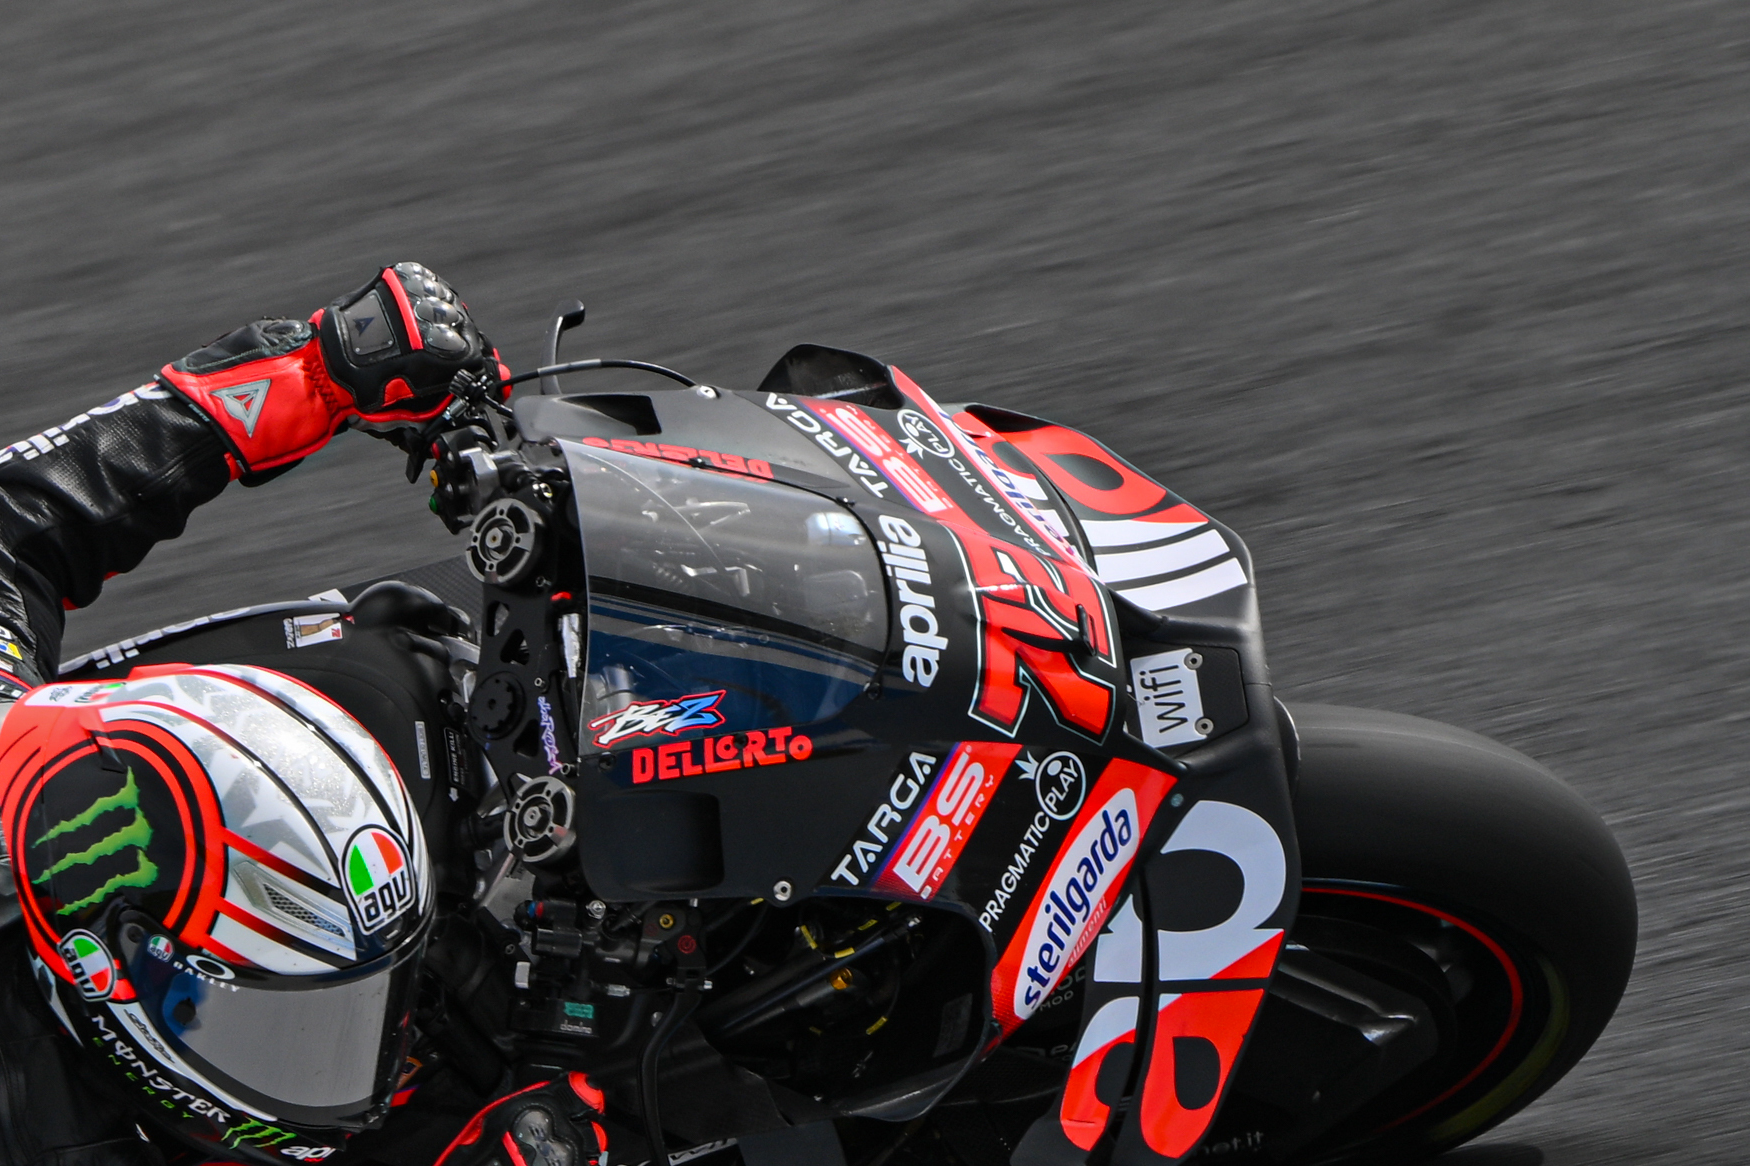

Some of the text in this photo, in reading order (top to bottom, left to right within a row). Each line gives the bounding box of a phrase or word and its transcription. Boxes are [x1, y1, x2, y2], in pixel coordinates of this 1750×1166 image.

[765, 392, 889, 499] TARGA
[826, 407, 948, 514] BS
[903, 412, 1053, 558] PRAGMATIC PLAY
[877, 514, 949, 689] aprilia
[940, 520, 1118, 746] 72
[1139, 663, 1189, 735] wifi
[830, 751, 937, 888] TARGA
[892, 748, 987, 894] BS
[920, 774, 997, 901] BATTERY
[979, 759, 1081, 934] PRAGMATIC PLAY
[363, 869, 407, 923] agv
[1024, 807, 1133, 1011] sterilgarda
[1067, 894, 1109, 969] alimenti
[63, 945, 97, 994] agv
[172, 960, 241, 993] OAKLEY
[92, 1036, 194, 1120] ENERGY
